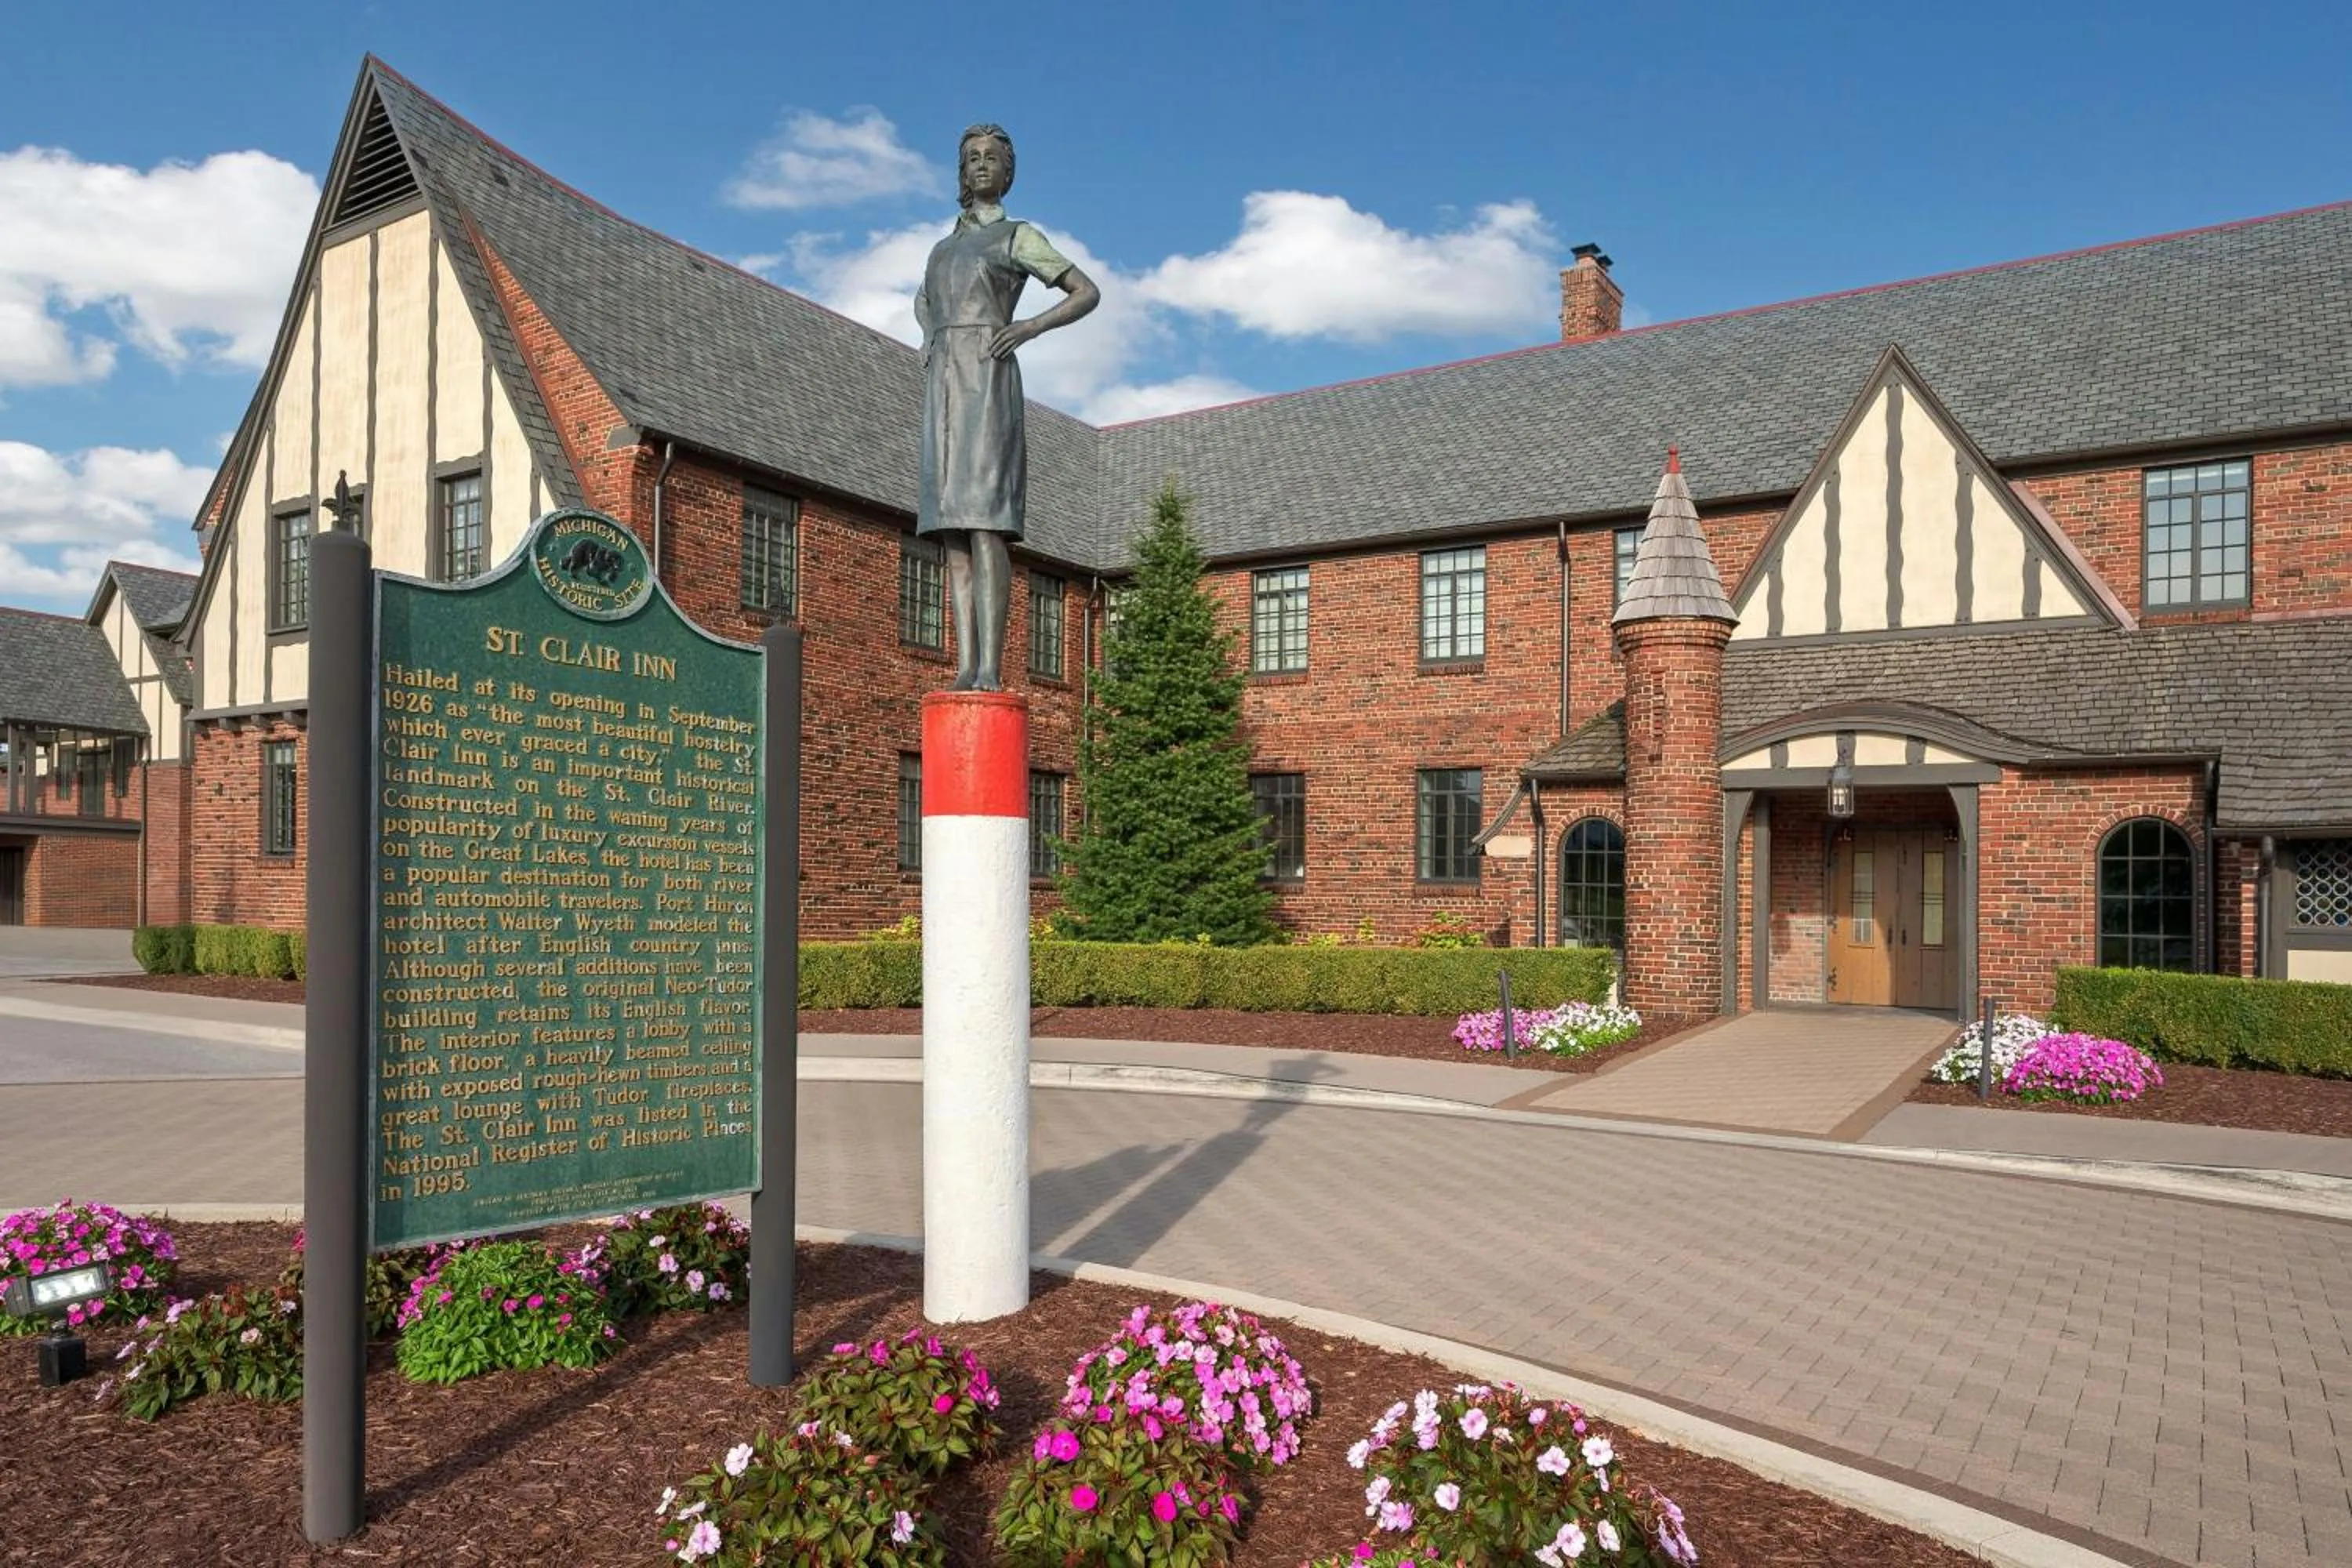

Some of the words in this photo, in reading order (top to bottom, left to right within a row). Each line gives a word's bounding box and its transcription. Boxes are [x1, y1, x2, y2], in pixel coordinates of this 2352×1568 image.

[554, 519, 628, 550] MICHIGAN
[539, 556, 603, 610] HISTORIC
[615, 579, 646, 608] SITE
[541, 637, 621, 672] CLAIR
[634, 652, 677, 681] INN
[386, 663, 459, 691] Hailed
[475, 678, 495, 697] at
[511, 683, 536, 702] its
[550, 691, 625, 718] opening
[639, 703, 655, 720] in
[669, 706, 755, 735] September
[384, 689, 433, 713] 1926
[446, 702, 468, 719] as
[537, 711, 582, 732] most
[684, 730, 755, 758] hostelry
[387, 717, 448, 739] which
[462, 729, 504, 746] ever
[522, 731, 587, 756] graced
[599, 742, 610, 757] a
[697, 753, 724, 773] the
[384, 739, 439, 760] Clair
[454, 745, 488, 766] Inn
[502, 752, 518, 768] is
[532, 757, 557, 773] an
[568, 758, 662, 784] important
[677, 772, 754, 795] historical
[385, 762, 494, 790] landmark
[516, 777, 539, 793] on
[557, 778, 587, 800] the
[648, 788, 692, 808] Clair
[708, 793, 756, 815] River.
[384, 788, 518, 815] Constructed
[535, 800, 553, 819] in
[566, 804, 595, 822] the
[680, 818, 727, 833] years
[737, 819, 753, 835] of
[384, 814, 501, 841] popularity
[512, 821, 534, 841] of
[542, 824, 607, 848] luxury
[617, 831, 696, 851] excursion
[705, 839, 755, 856] vessels
[383, 841, 409, 857] on
[419, 839, 454, 860] the
[464, 841, 521, 862] Great
[601, 849, 629, 868] the
[639, 851, 681, 871] hotel
[685, 854, 711, 872] has
[719, 855, 753, 875] been
[383, 869, 396, 881] a
[408, 866, 489, 884] popular
[502, 867, 609, 885] destination
[622, 871, 648, 889] for
[665, 874, 702, 891] both
[714, 877, 753, 894] river
[384, 887, 423, 906] and
[434, 887, 551, 909] automobile
[657, 894, 693, 912] Port
[705, 897, 753, 915] Huron
[384, 909, 488, 930] architect
[499, 913, 562, 931] Walter
[576, 915, 635, 934] Wyeth
[648, 916, 717, 933] modeled
[728, 918, 753, 934] the
[385, 937, 445, 954] hotel
[466, 937, 521, 954] after
[539, 936, 611, 956] English
[631, 940, 701, 956] country
[384, 958, 485, 980] Although
[495, 958, 564, 976] several
[576, 957, 657, 975] additions
[665, 957, 702, 974] have
[716, 958, 753, 975] been
[537, 980, 568, 996] the
[583, 980, 655, 999] original
[384, 1009, 477, 1030] building
[496, 1006, 570, 1022] retains
[587, 1002, 612, 1018] its
[622, 1001, 686, 1022] English
[384, 1033, 426, 1052] The
[439, 1031, 521, 1051] interior
[532, 1026, 615, 1046] features
[627, 1028, 635, 1040] a
[643, 1022, 690, 1041] lobby
[703, 1020, 738, 1036] with
[742, 1021, 752, 1033] a
[383, 1057, 441, 1077] brick
[525, 1054, 537, 1067] a
[547, 1046, 613, 1069] heavily
[626, 1043, 690, 1062] beamed
[702, 1040, 752, 1058] ceiling
[384, 1081, 430, 1101] with
[441, 1073, 522, 1099] exposed
[647, 1063, 706, 1080] timbers
[711, 1061, 739, 1076] and
[383, 1106, 441, 1127] great
[453, 1100, 523, 1123] lounge
[537, 1093, 582, 1112] with
[593, 1087, 648, 1108] Tudor
[384, 1131, 425, 1150] The
[482, 1120, 535, 1141] Clair
[546, 1116, 577, 1134] Inn
[590, 1113, 624, 1128] was
[638, 1105, 688, 1123] listed
[728, 1100, 753, 1115] the
[384, 1148, 480, 1174] National
[492, 1139, 578, 1163] Register
[589, 1132, 608, 1150] of
[622, 1127, 691, 1147] Historic
[382, 1184, 401, 1202] in
[413, 1171, 472, 1196] 1995.
